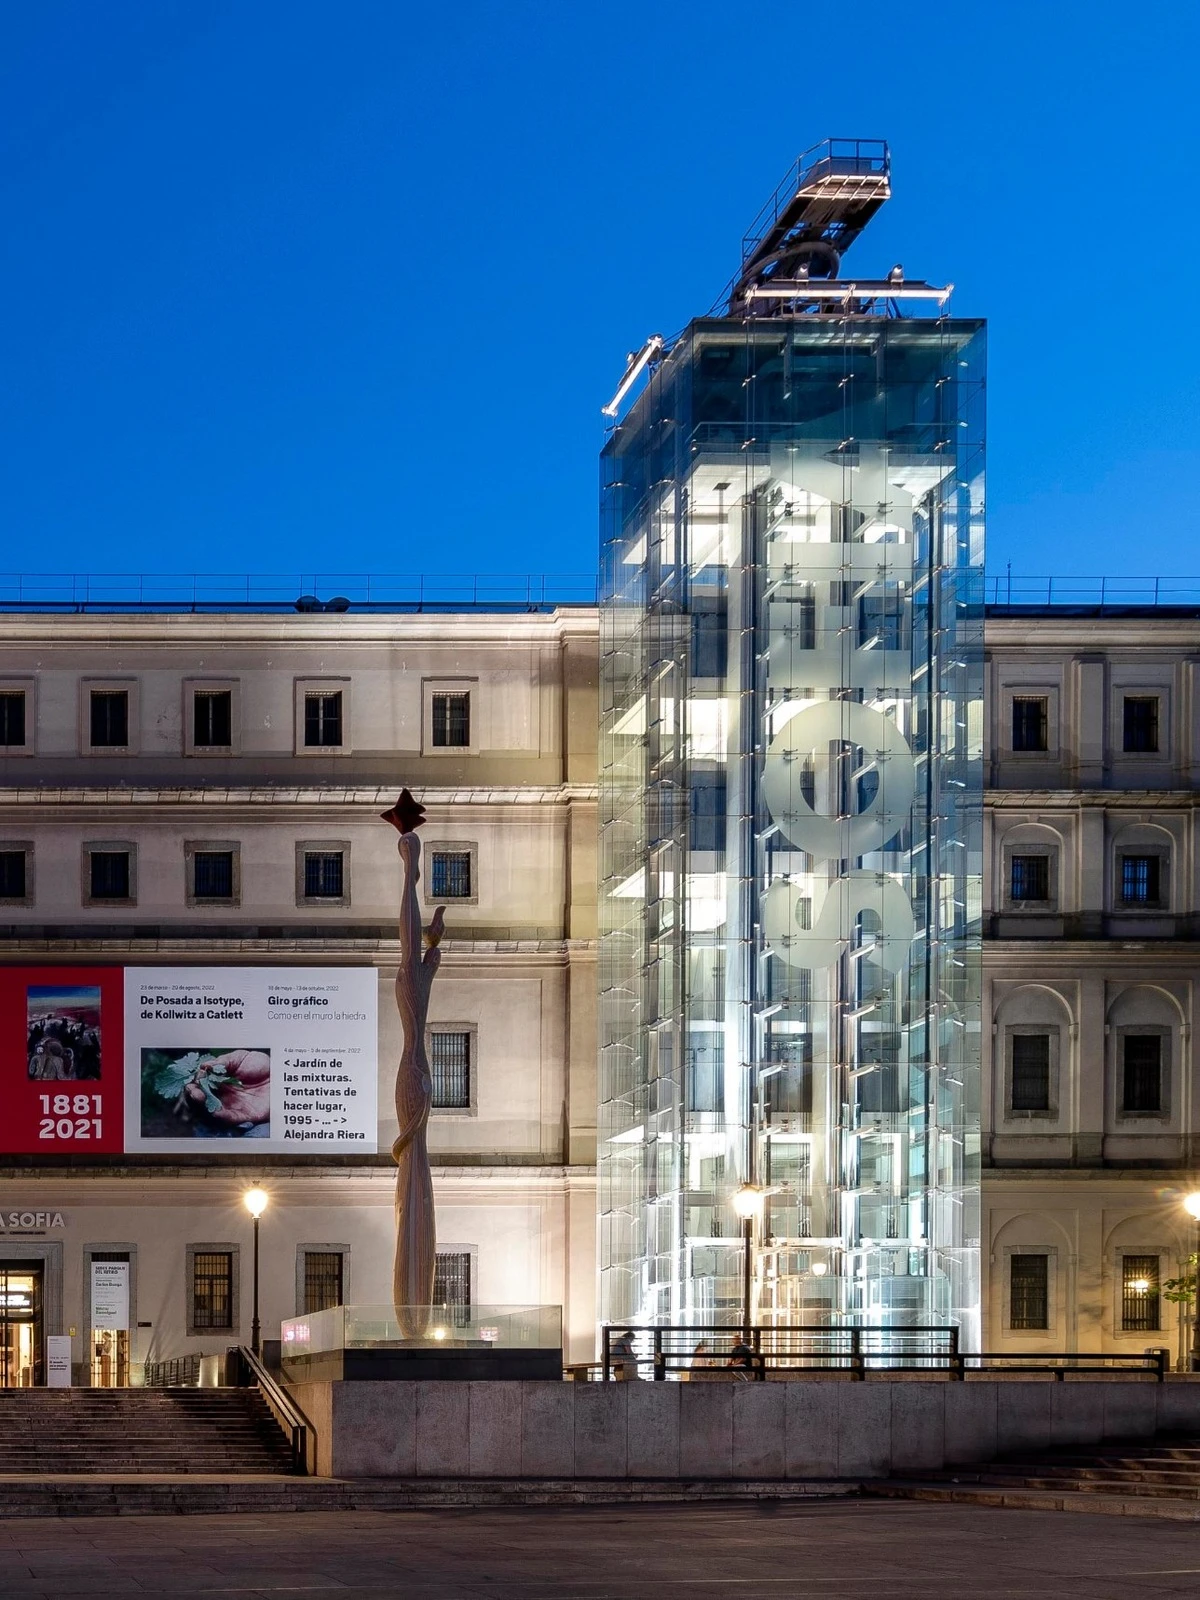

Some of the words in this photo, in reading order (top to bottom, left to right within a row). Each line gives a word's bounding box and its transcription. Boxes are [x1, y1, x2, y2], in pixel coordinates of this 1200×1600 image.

[764, 392, 915, 973] SOFIA
[140, 996, 154, 1005] De
[156, 996, 193, 1005] Posada
[204, 996, 244, 1007] Isotype,
[268, 996, 290, 1006] Giro
[291, 996, 328, 1008] gráfico
[140, 1010, 153, 1019] de
[155, 1010, 197, 1019] Kollwitz
[206, 1010, 243, 1020] Catlett
[267, 1011, 291, 1020] Como
[292, 1012, 302, 1020] en
[304, 1011, 311, 1020] el
[312, 1012, 333, 1021] muro
[334, 1011, 341, 1021] la
[342, 1011, 366, 1021] hiedra
[293, 1058, 327, 1067] Jardín
[329, 1058, 343, 1067] de
[284, 1072, 299, 1082] las
[301, 1072, 352, 1082] mixturas.
[284, 1087, 341, 1096] Tentativas
[343, 1087, 357, 1096] de
[39, 1095, 102, 1115] 1881
[284, 1101, 313, 1110] hacer
[315, 1101, 346, 1112] lugar,
[284, 1115, 312, 1124] 1995
[39, 1118, 102, 1139] 2021
[284, 1129, 334, 1141] Alejandra
[337, 1130, 365, 1140] Riera
[8, 1212, 66, 1228] SOFIA
